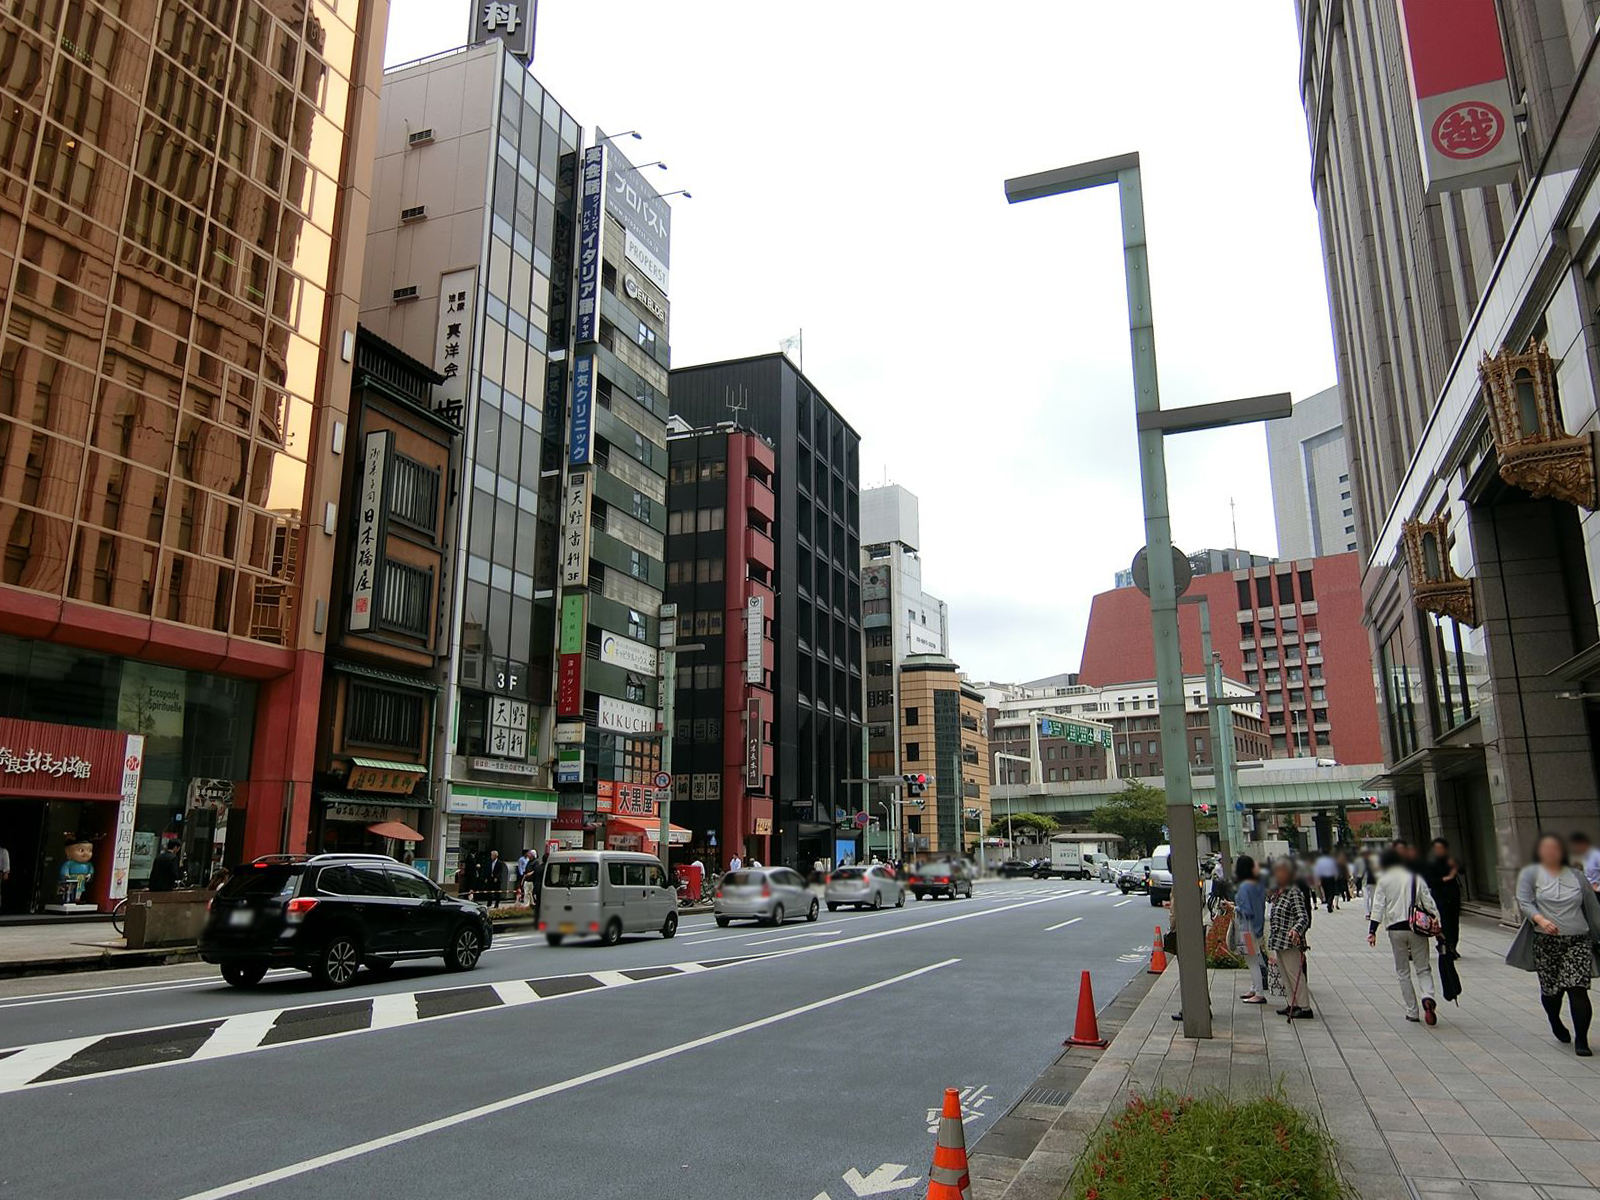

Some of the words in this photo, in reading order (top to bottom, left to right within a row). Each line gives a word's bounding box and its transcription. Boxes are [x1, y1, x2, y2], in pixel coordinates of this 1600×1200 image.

[483, 1, 521, 34] 科
[584, 149, 602, 196] 英会話
[614, 172, 667, 238] プロパスト
[578, 232, 597, 315] イタリア語
[629, 241, 666, 286] PROPERST
[444, 323, 461, 379] 真洋会
[573, 358, 590, 460] 恵友クリニック
[355, 508, 374, 592] 日本橋屋
[567, 490, 583, 567] 天野歯科
[567, 572, 579, 581] 3F
[495, 702, 525, 726] 天野
[602, 711, 652, 732] KIKUCHI
[0, 747, 92, 779] 奈良まほろば館
[116, 774, 138, 862] 開館10周年
[483, 798, 521, 813] FamilyMart
[619, 785, 653, 813] 大黒屋
